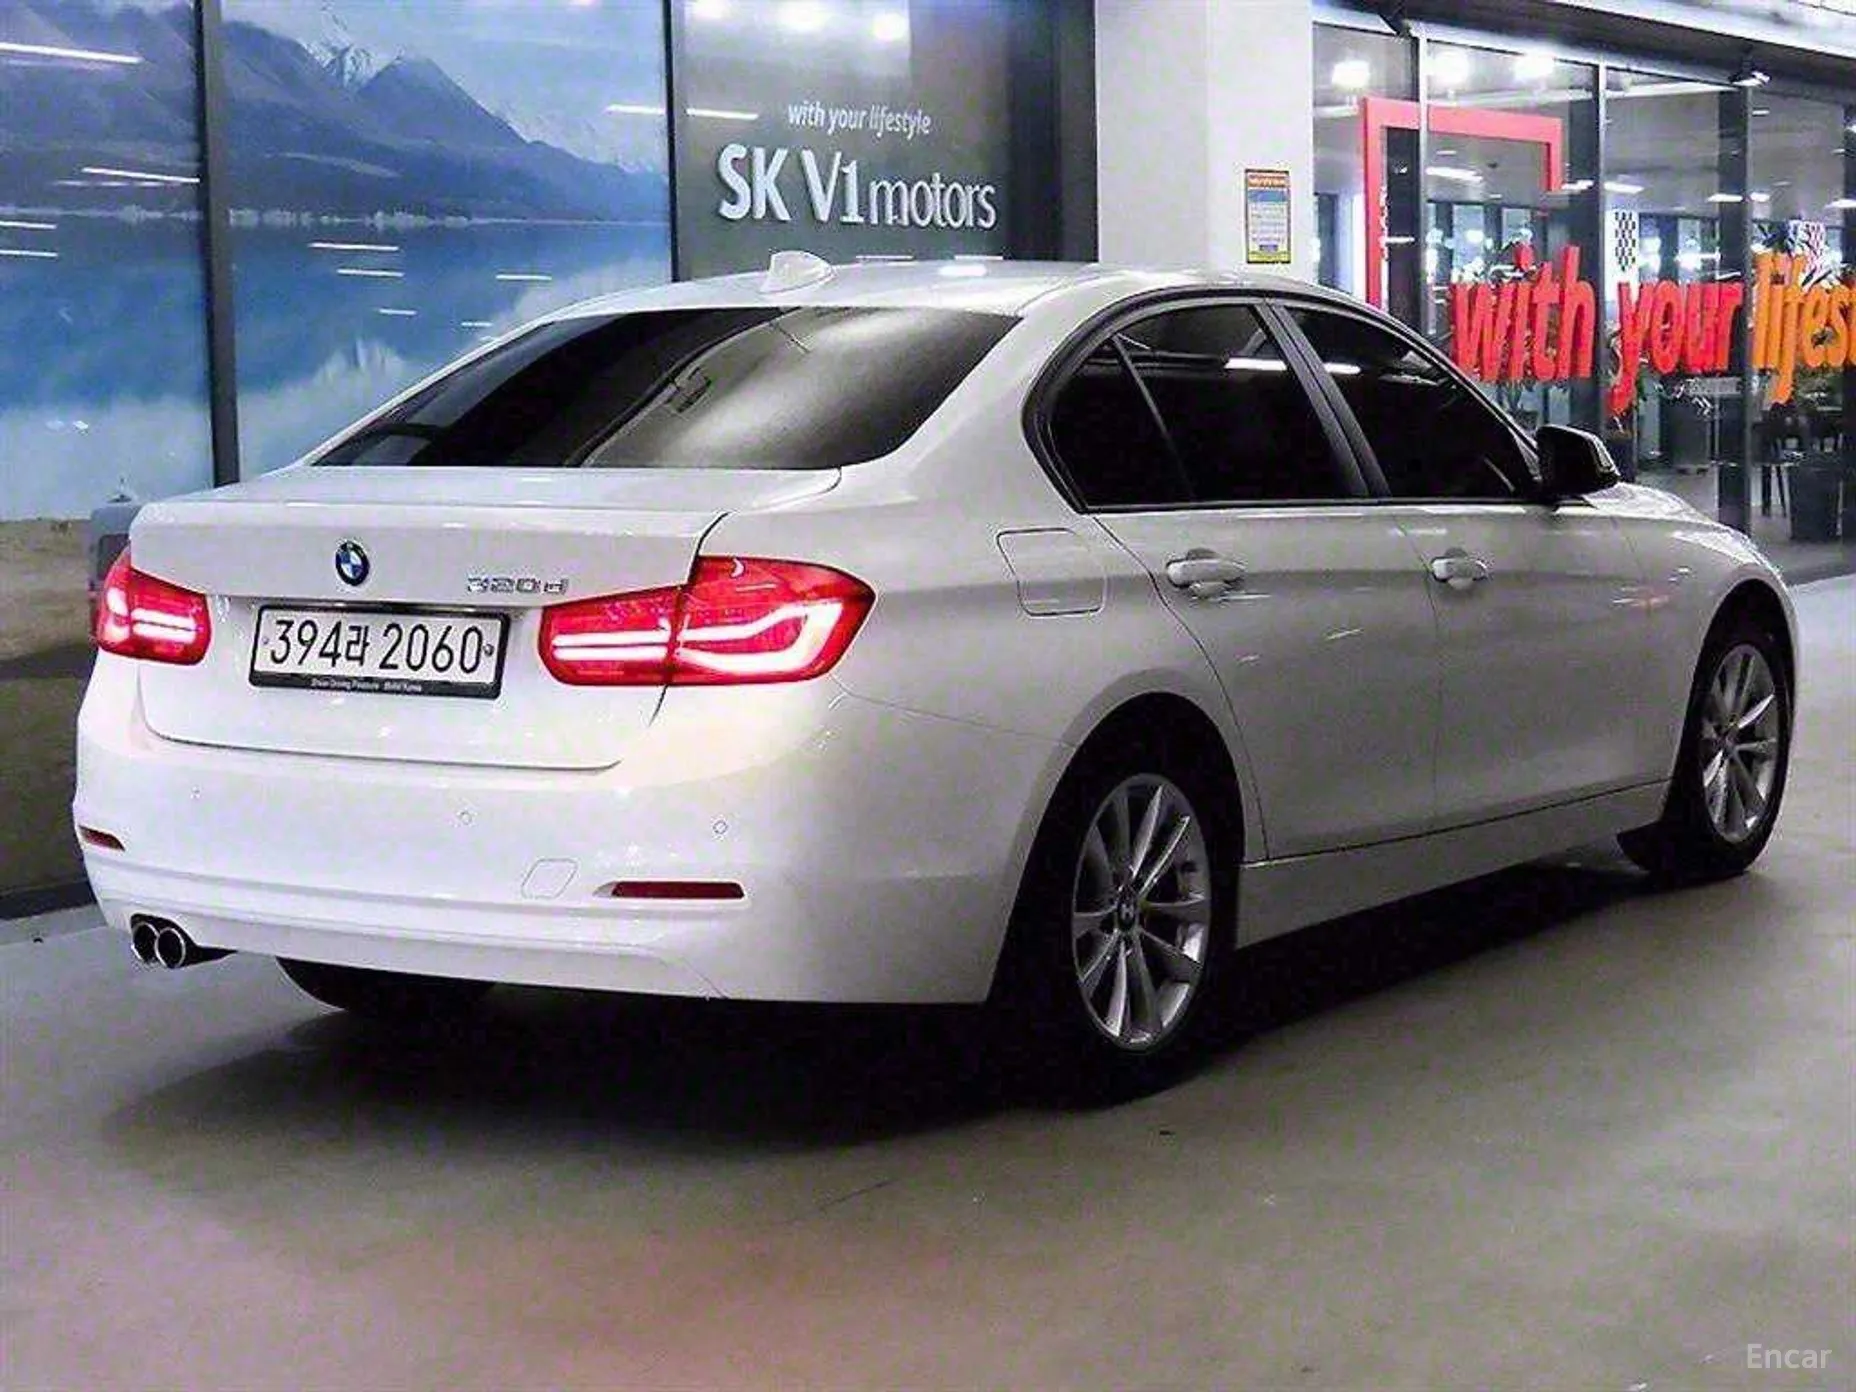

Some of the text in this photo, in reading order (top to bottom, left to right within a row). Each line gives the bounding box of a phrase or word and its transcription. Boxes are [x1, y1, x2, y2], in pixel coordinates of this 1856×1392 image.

[787, 100, 931, 140] with your lifestyle
[717, 143, 792, 220] SK
[1451, 244, 1595, 382] with
[1609, 279, 1744, 414] your
[467, 577, 569, 595] 320d
[270, 619, 484, 674] 394라 2060
